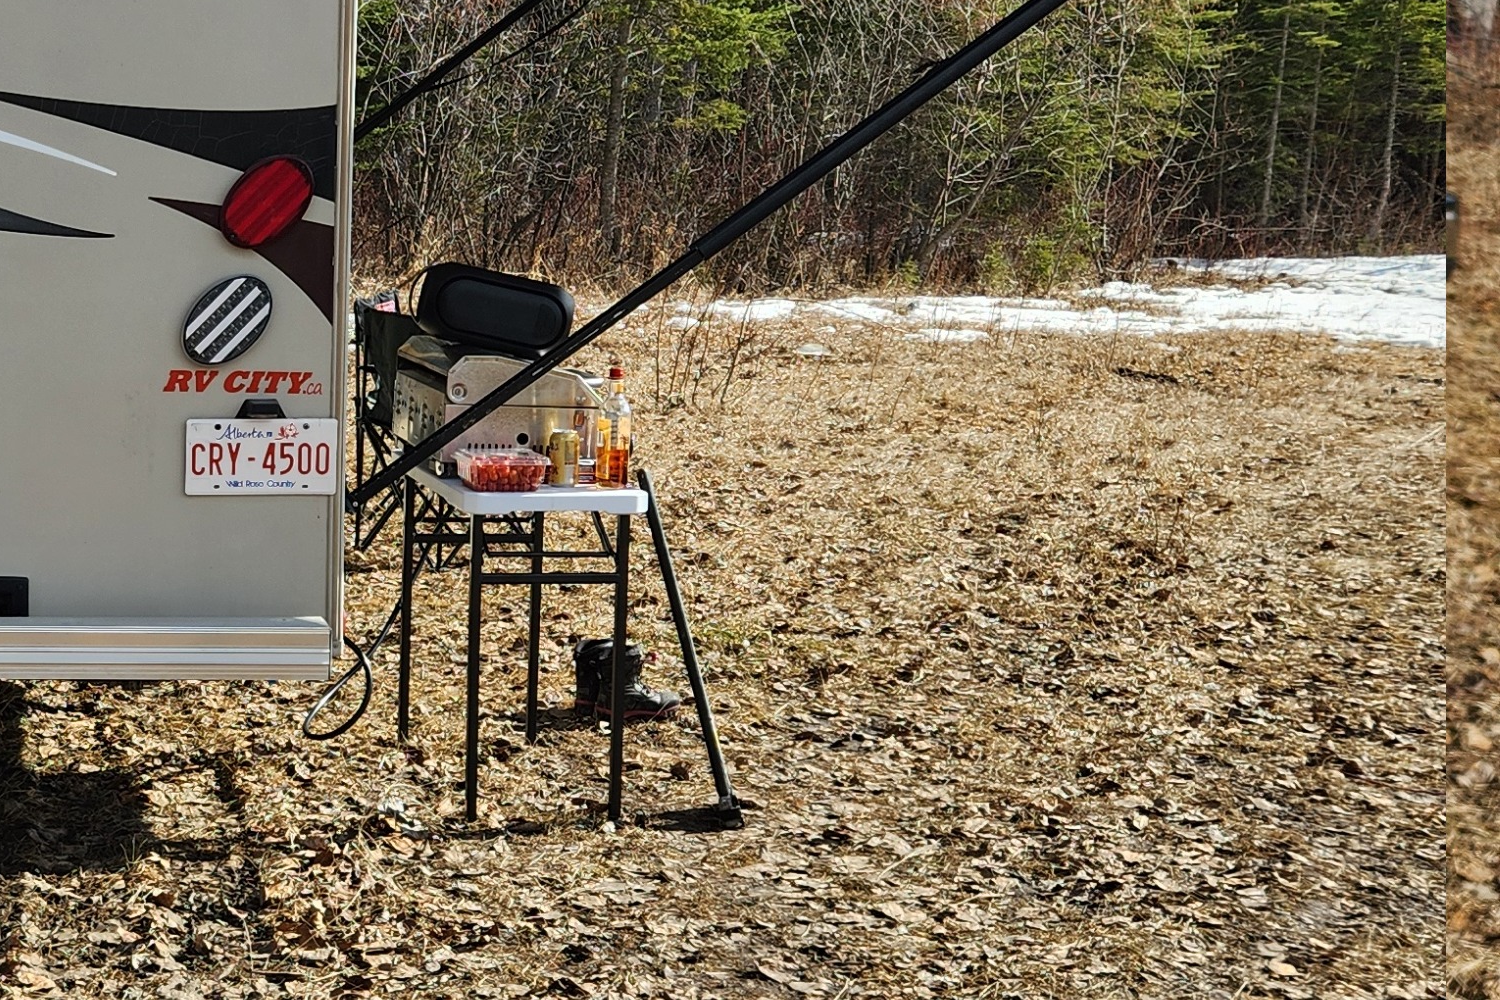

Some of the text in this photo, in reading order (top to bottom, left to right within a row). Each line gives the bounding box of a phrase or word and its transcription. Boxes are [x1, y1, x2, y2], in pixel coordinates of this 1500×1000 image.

[162, 370, 219, 393] RV
[216, 423, 268, 440] Alberta
[225, 479, 243, 488] Wild
[266, 479, 296, 489] Country
